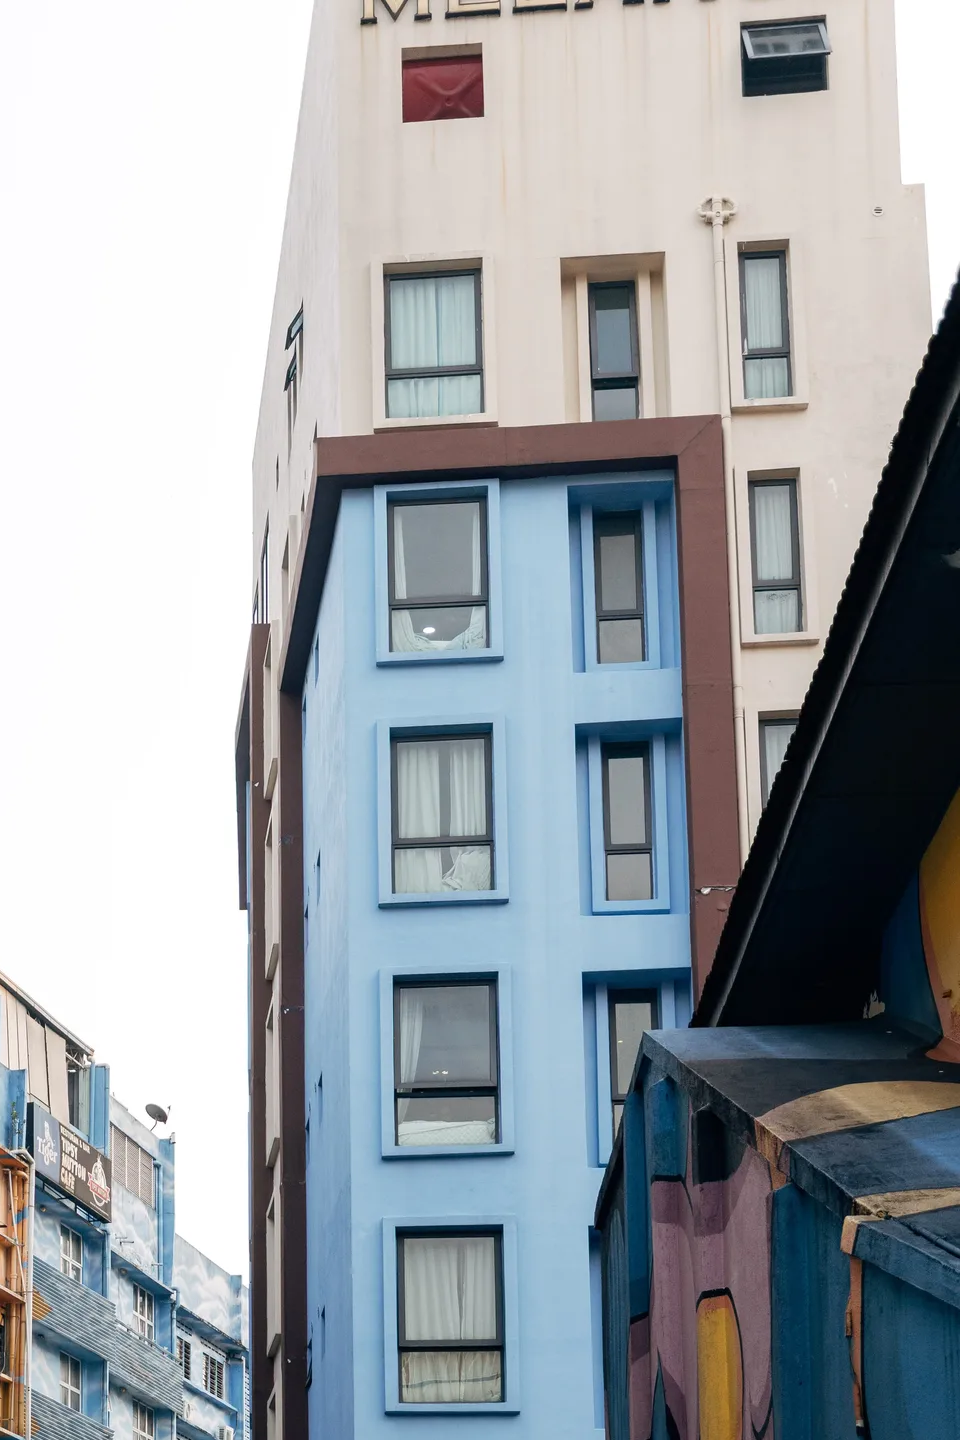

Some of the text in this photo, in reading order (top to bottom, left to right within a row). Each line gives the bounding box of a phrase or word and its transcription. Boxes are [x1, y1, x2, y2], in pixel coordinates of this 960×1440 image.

[36, 1136, 58, 1166] Tiger
[61, 1135, 78, 1160] TIPSY
[61, 1152, 87, 1181] MUTTON
